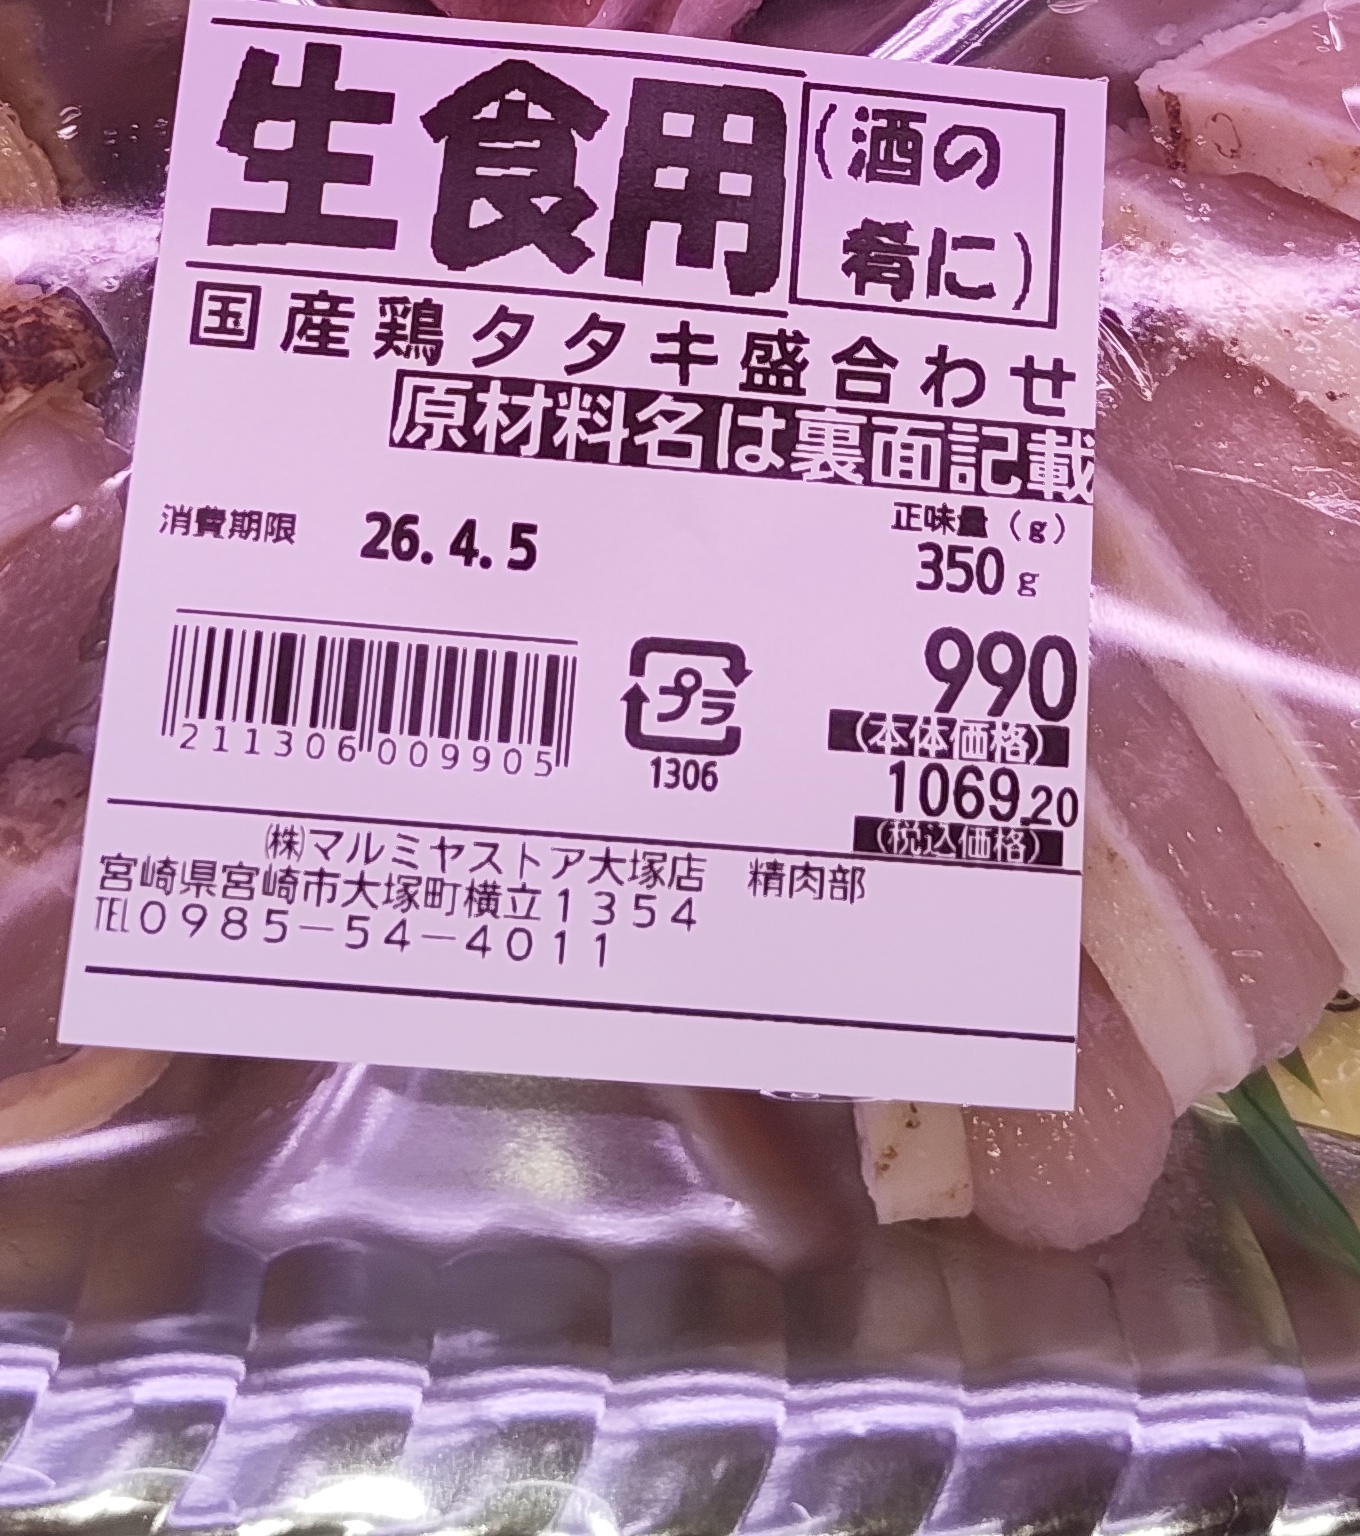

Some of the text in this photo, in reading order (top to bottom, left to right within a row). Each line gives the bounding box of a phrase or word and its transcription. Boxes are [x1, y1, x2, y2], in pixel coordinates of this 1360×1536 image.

[207, 42, 787, 297] 生食用
[814, 103, 1001, 190] (酒の
[841, 217, 1033, 311] 肴に)
[188, 279, 1078, 420] 国産鶏タタキ盛合わせ
[393, 374, 1094, 502] 原材料名は裏面記載
[158, 503, 539, 572] 消費期限 26.4.5
[915, 541, 1005, 596] 350
[656, 666, 737, 726] プラ
[924, 626, 1078, 723] 990
[854, 711, 1044, 766] (本体価格)
[649, 755, 719, 793] 1306
[876, 819, 1041, 865] (税込価格)
[748, 858, 867, 905] 精肉部
